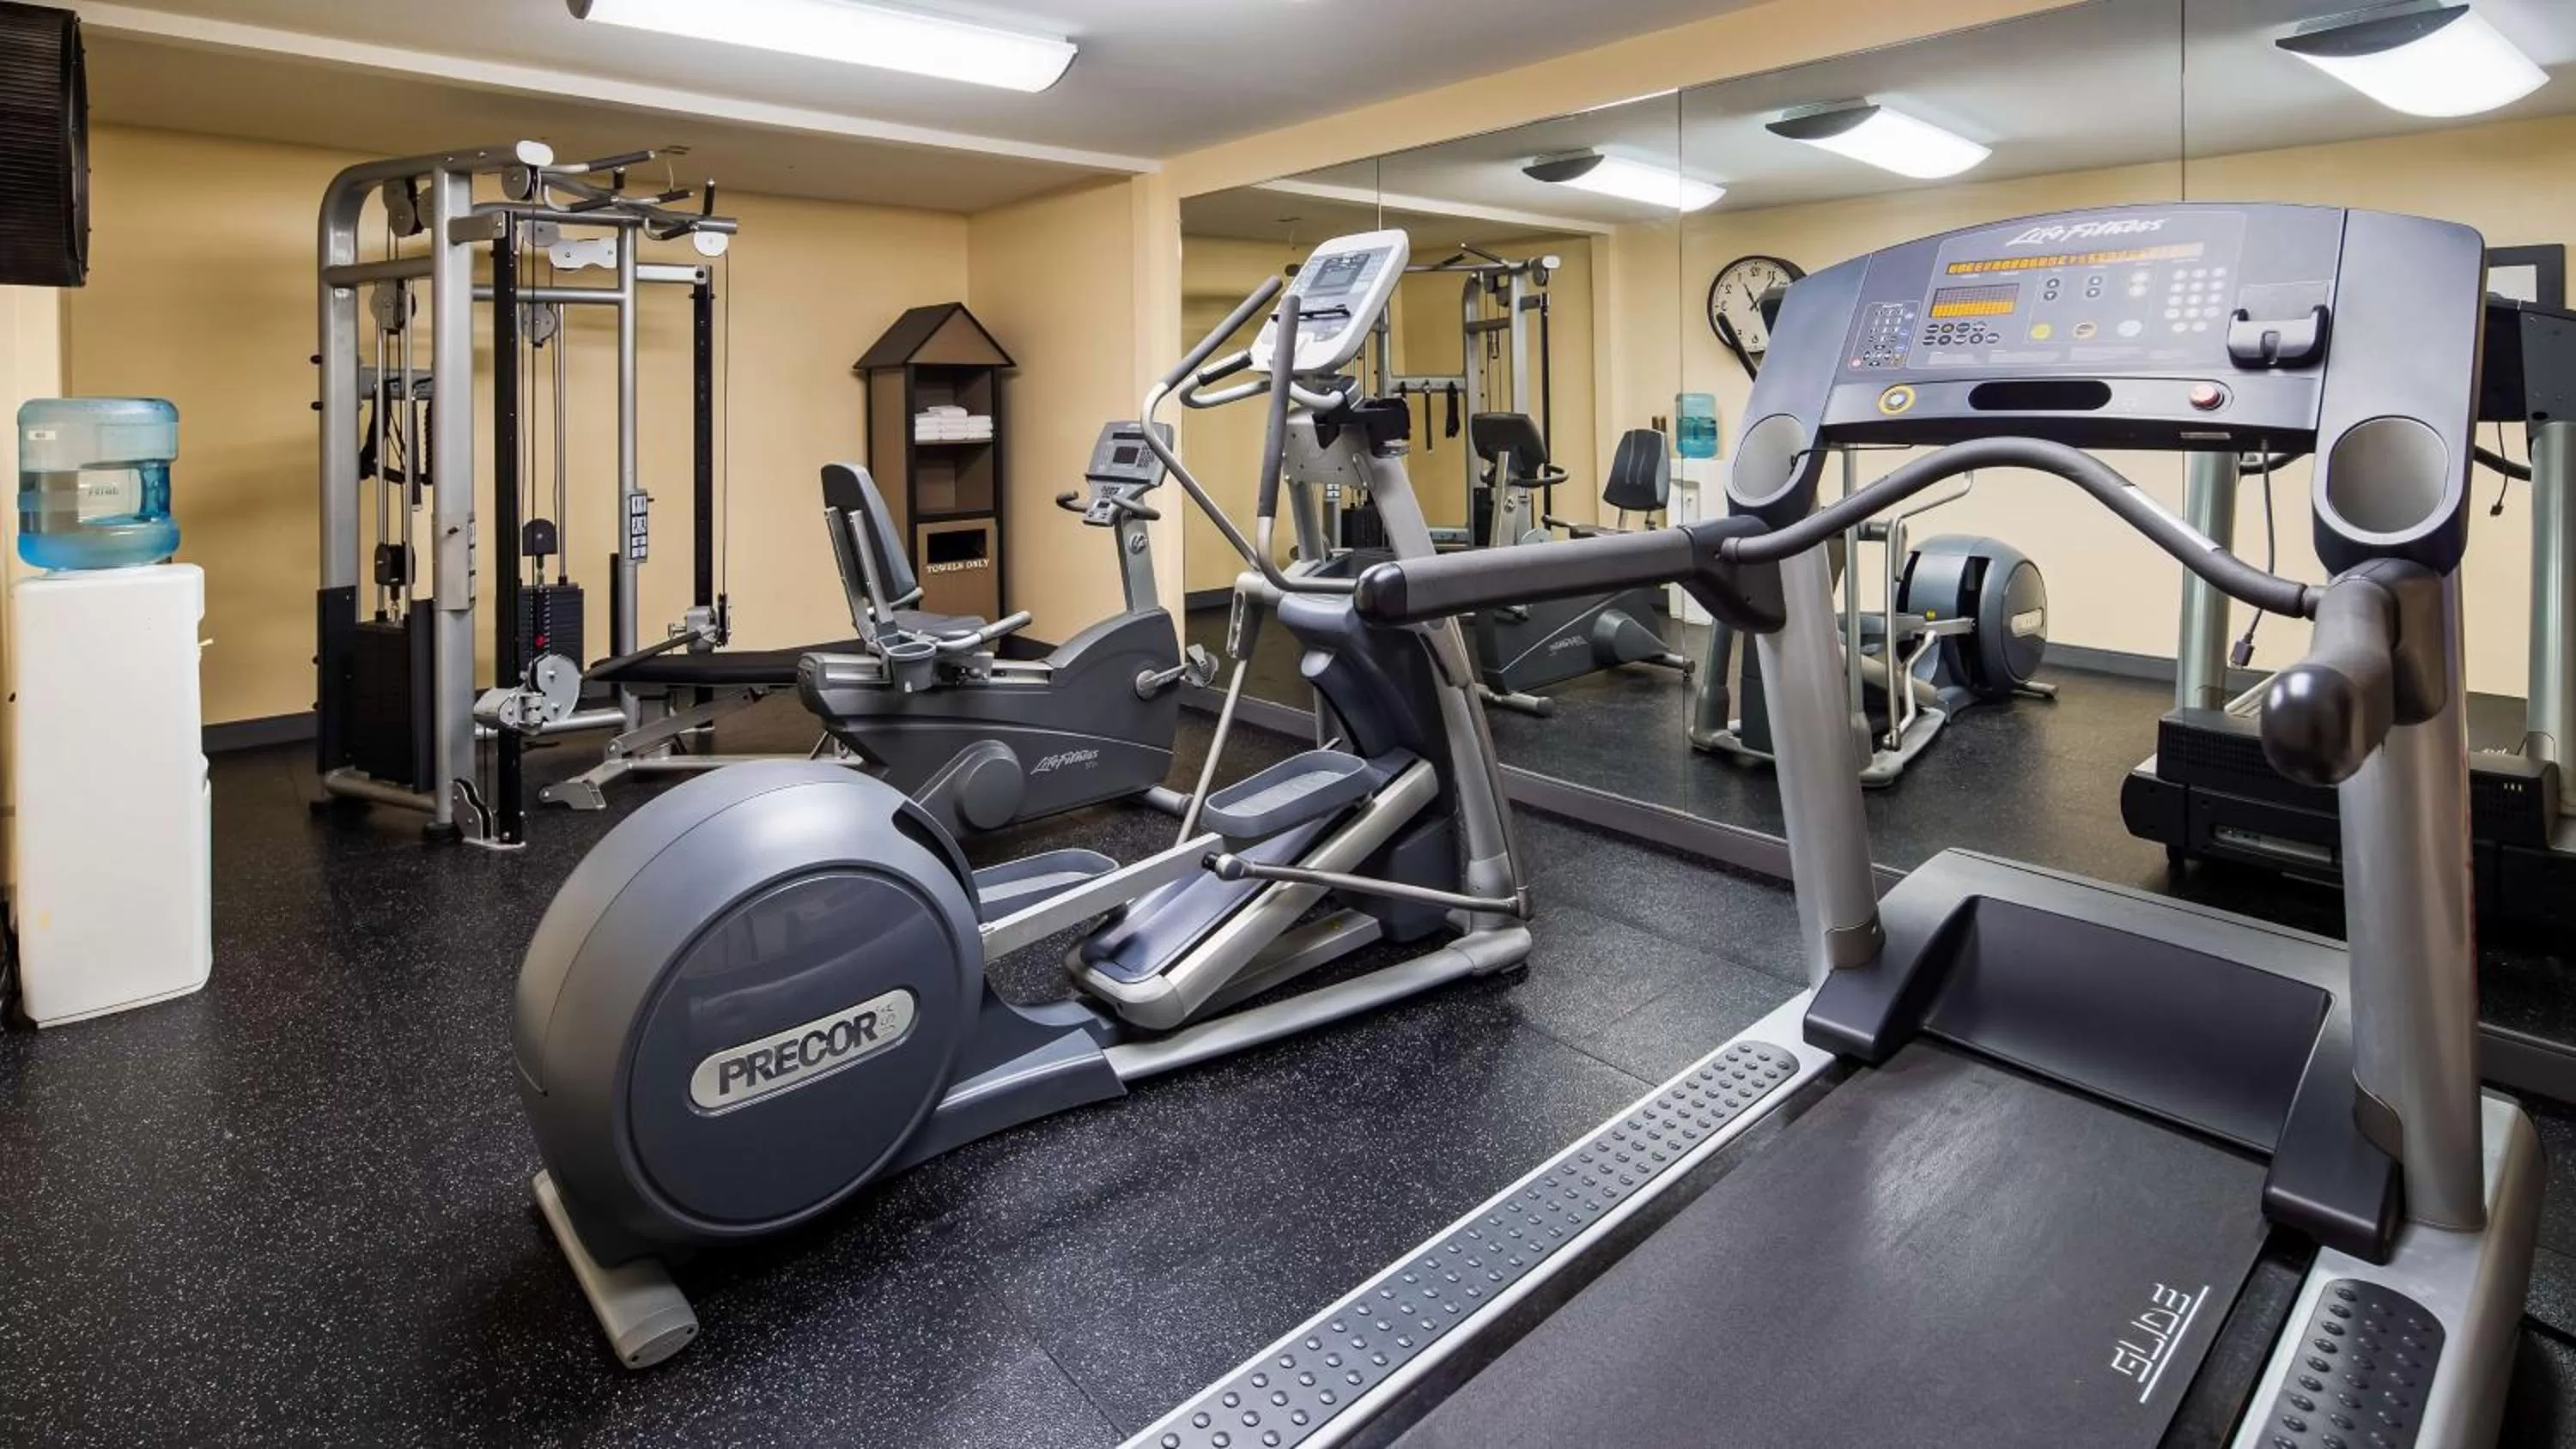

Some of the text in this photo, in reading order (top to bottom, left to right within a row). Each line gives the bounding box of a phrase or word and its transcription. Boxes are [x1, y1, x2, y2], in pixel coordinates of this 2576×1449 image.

[927, 560, 990, 573] TOWELS ONLY
[720, 1010, 878, 1095] PRECOR
[2111, 1283, 2190, 1383] GLIDE
